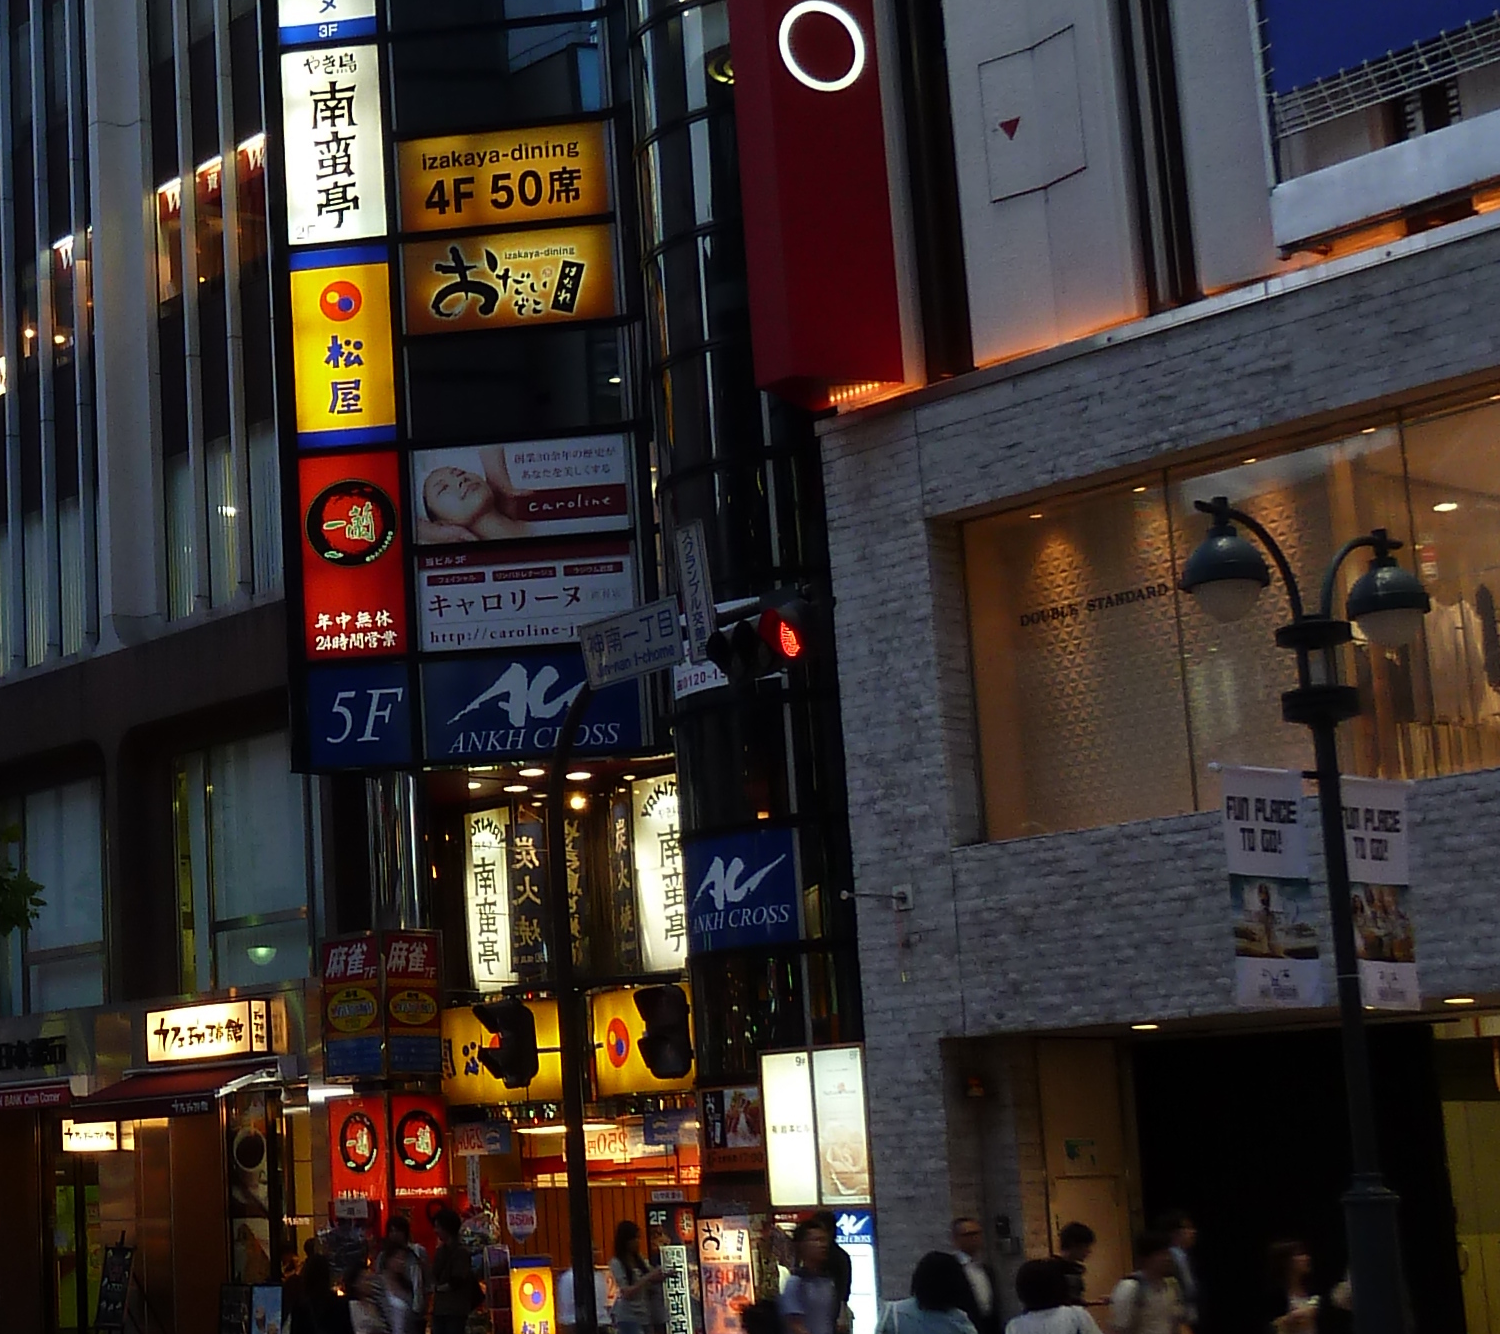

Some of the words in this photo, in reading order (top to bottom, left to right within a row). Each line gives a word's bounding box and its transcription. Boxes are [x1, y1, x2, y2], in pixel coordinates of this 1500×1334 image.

[317, 23, 338, 39] 3F
[303, 53, 358, 75] やき鳥
[310, 81, 360, 229] 南蛮亭
[421, 141, 580, 171] izakaya-dining
[425, 178, 476, 215] 4F
[490, 167, 583, 209] 50席
[504, 245, 576, 261] izakaya-dining
[324, 335, 365, 415] 松屋
[528, 495, 612, 513] caroline
[323, 500, 376, 543] 一蘭
[428, 585, 581, 618] キャロリーヌ
[1020, 601, 1079, 627] DOUBLE
[1087, 582, 1169, 612] STANDARD
[315, 610, 393, 632] 年中無休
[315, 631, 398, 652] 24時間営業
[587, 609, 675, 661] 神南一丁目
[327, 687, 403, 744] 5F
[449, 729, 525, 754] ANKH
[1226, 796, 1249, 821] FUN
[1255, 798, 1297, 823] PLACE
[1365, 809, 1401, 832] PLACE
[1240, 828, 1256, 851] TO
[1261, 829, 1282, 853] GO!
[728, 904, 791, 926] CROSS
[325, 944, 367, 978] 麻雀
[387, 942, 428, 973] 麻雀
[154, 1017, 244, 1052] カフェ珈琲館
[5, 1094, 22, 1106] BANK
[24, 1091, 38, 1103] Cash
[39, 1091, 60, 1102] Corner
[649, 1210, 667, 1224] 2F
